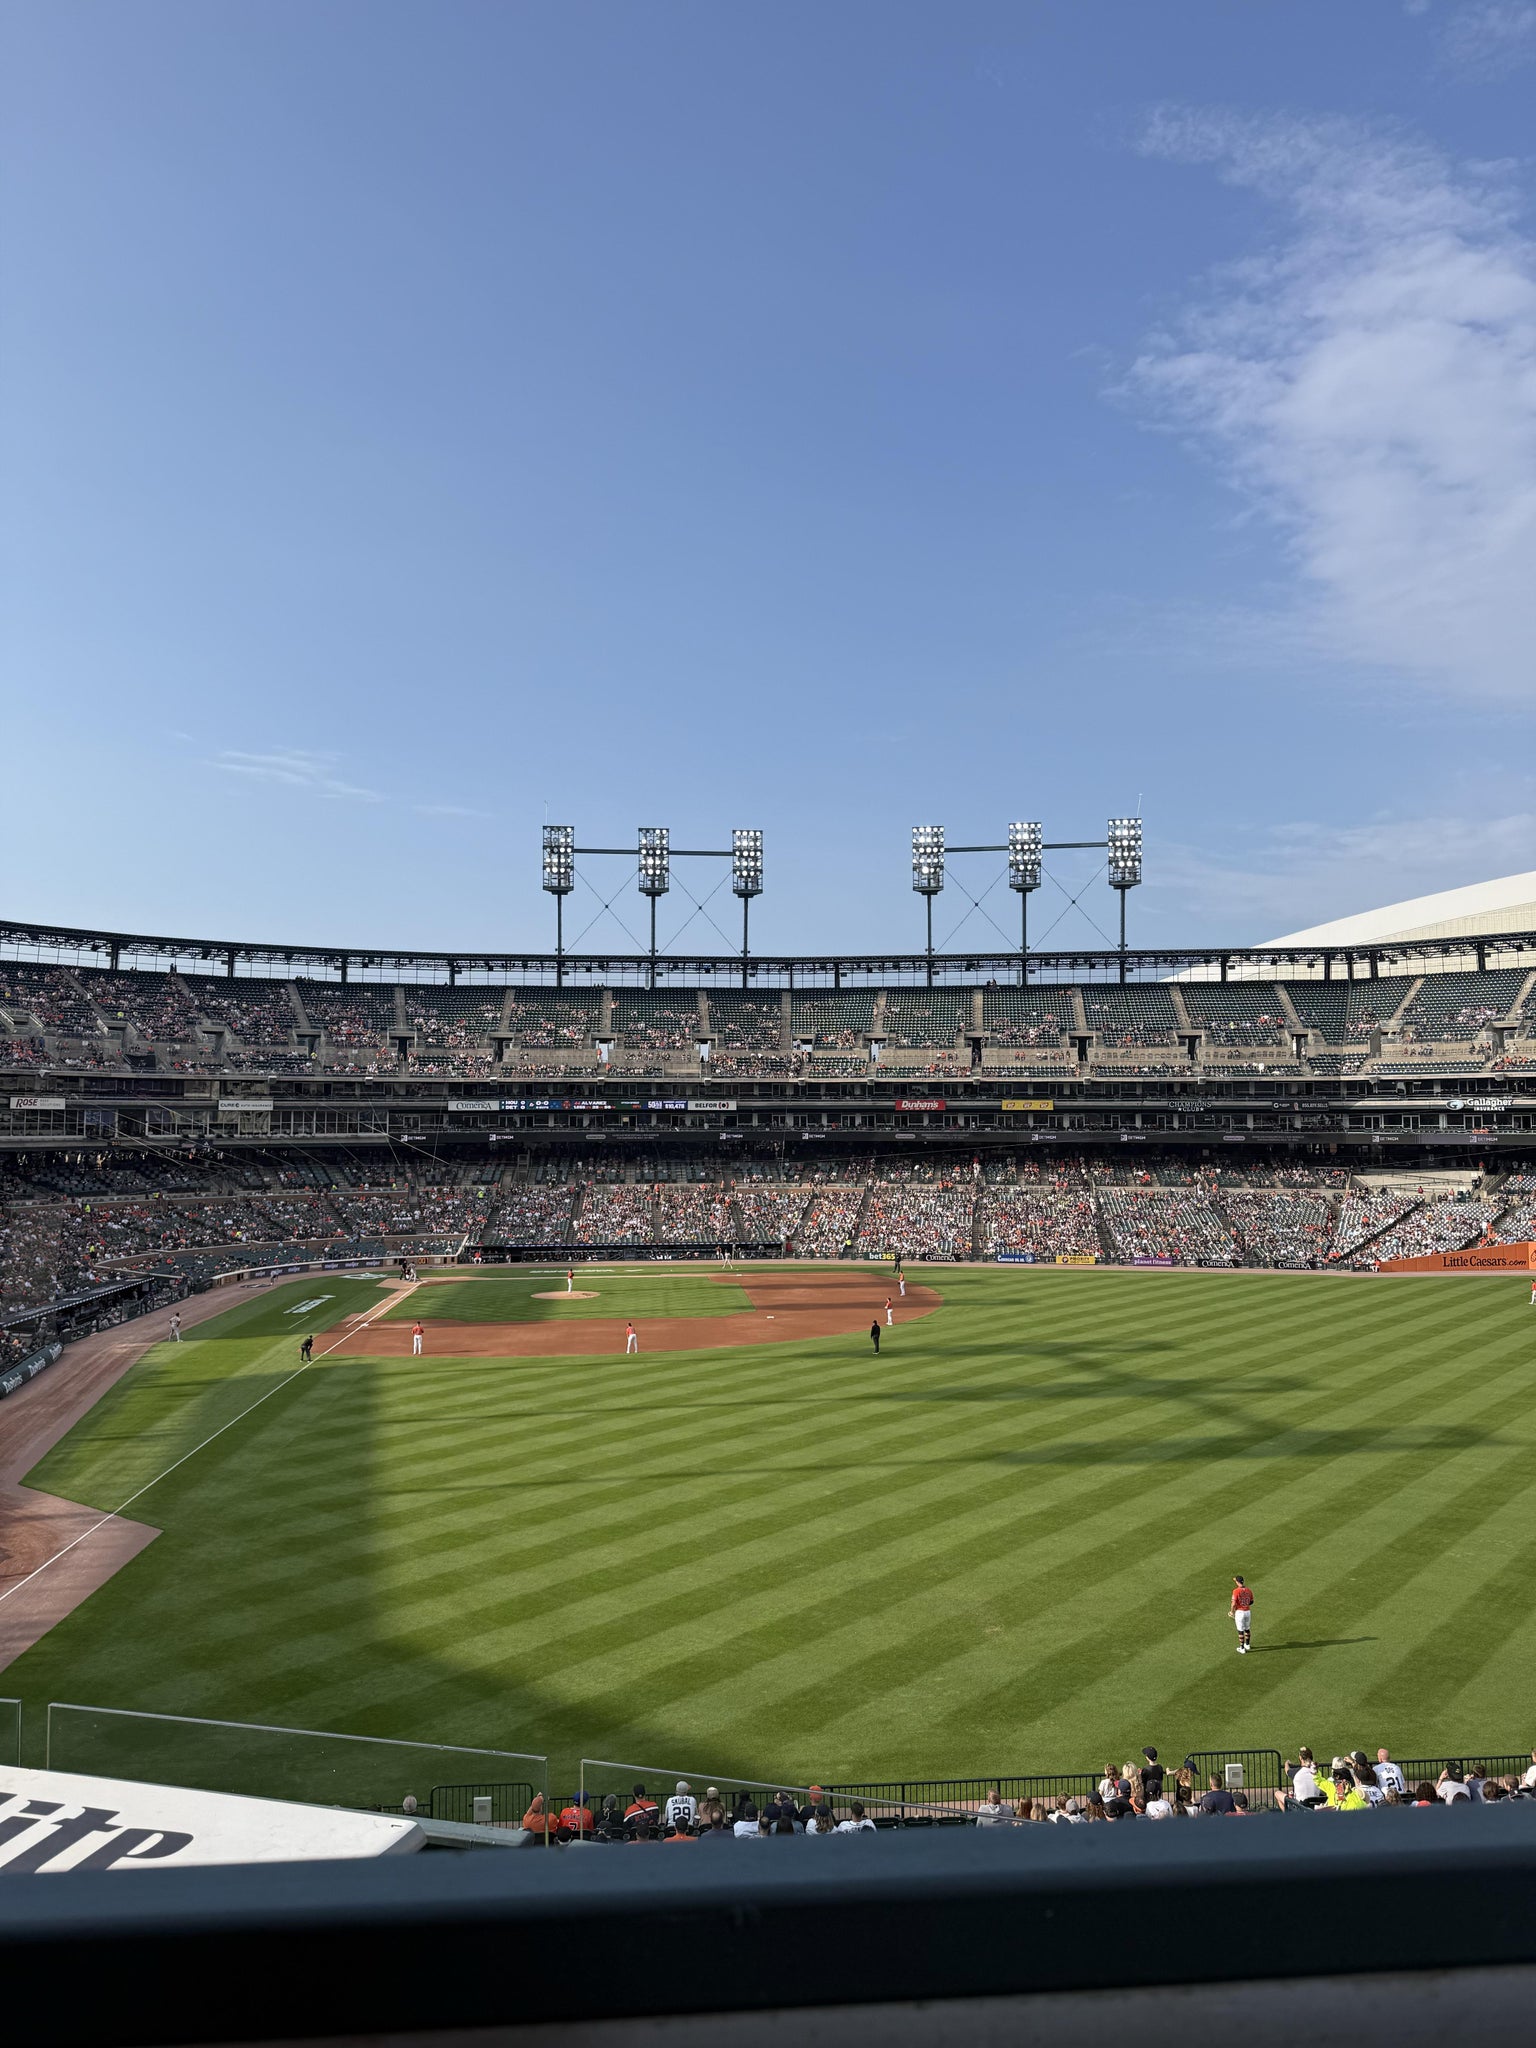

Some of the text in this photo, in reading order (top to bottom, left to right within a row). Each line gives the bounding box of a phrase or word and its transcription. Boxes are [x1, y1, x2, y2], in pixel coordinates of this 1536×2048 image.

[16, 1098, 38, 1107] ROSE
[1467, 1098, 1512, 1107] Gallagher
[1443, 1256, 1468, 1267] Little
[671, 1798, 692, 1806] SKUBAL
